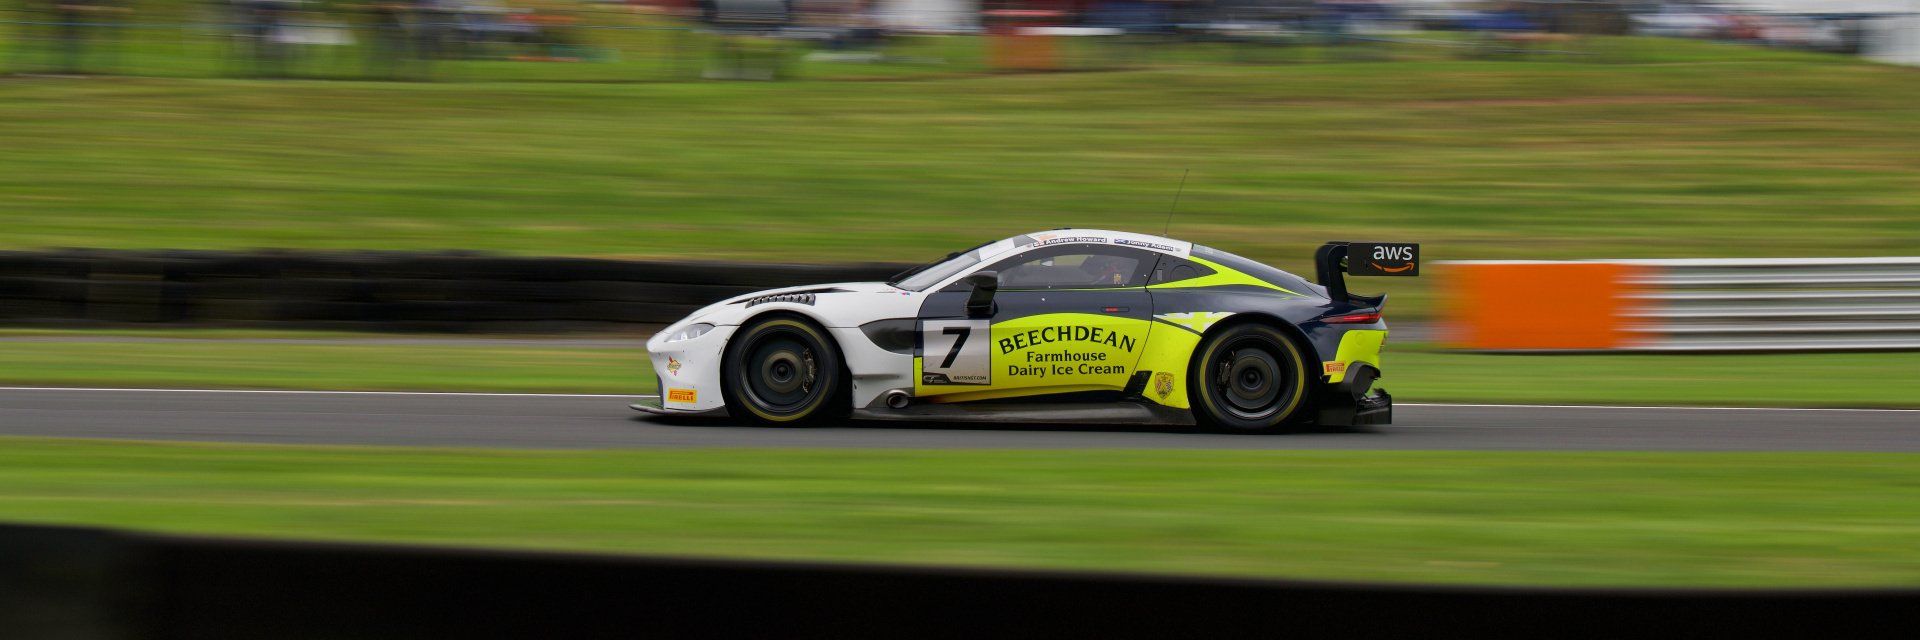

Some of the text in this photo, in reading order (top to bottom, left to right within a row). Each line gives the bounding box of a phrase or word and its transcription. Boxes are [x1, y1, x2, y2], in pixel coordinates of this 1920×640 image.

[1373, 245, 1413, 261] aws
[940, 326, 971, 368] 7
[998, 325, 1136, 355] BEECHDEAN
[1026, 350, 1107, 363] Farmhouse
[1008, 363, 1125, 378] Dairy Ice Cream
[670, 390, 694, 401] PIRELLI
